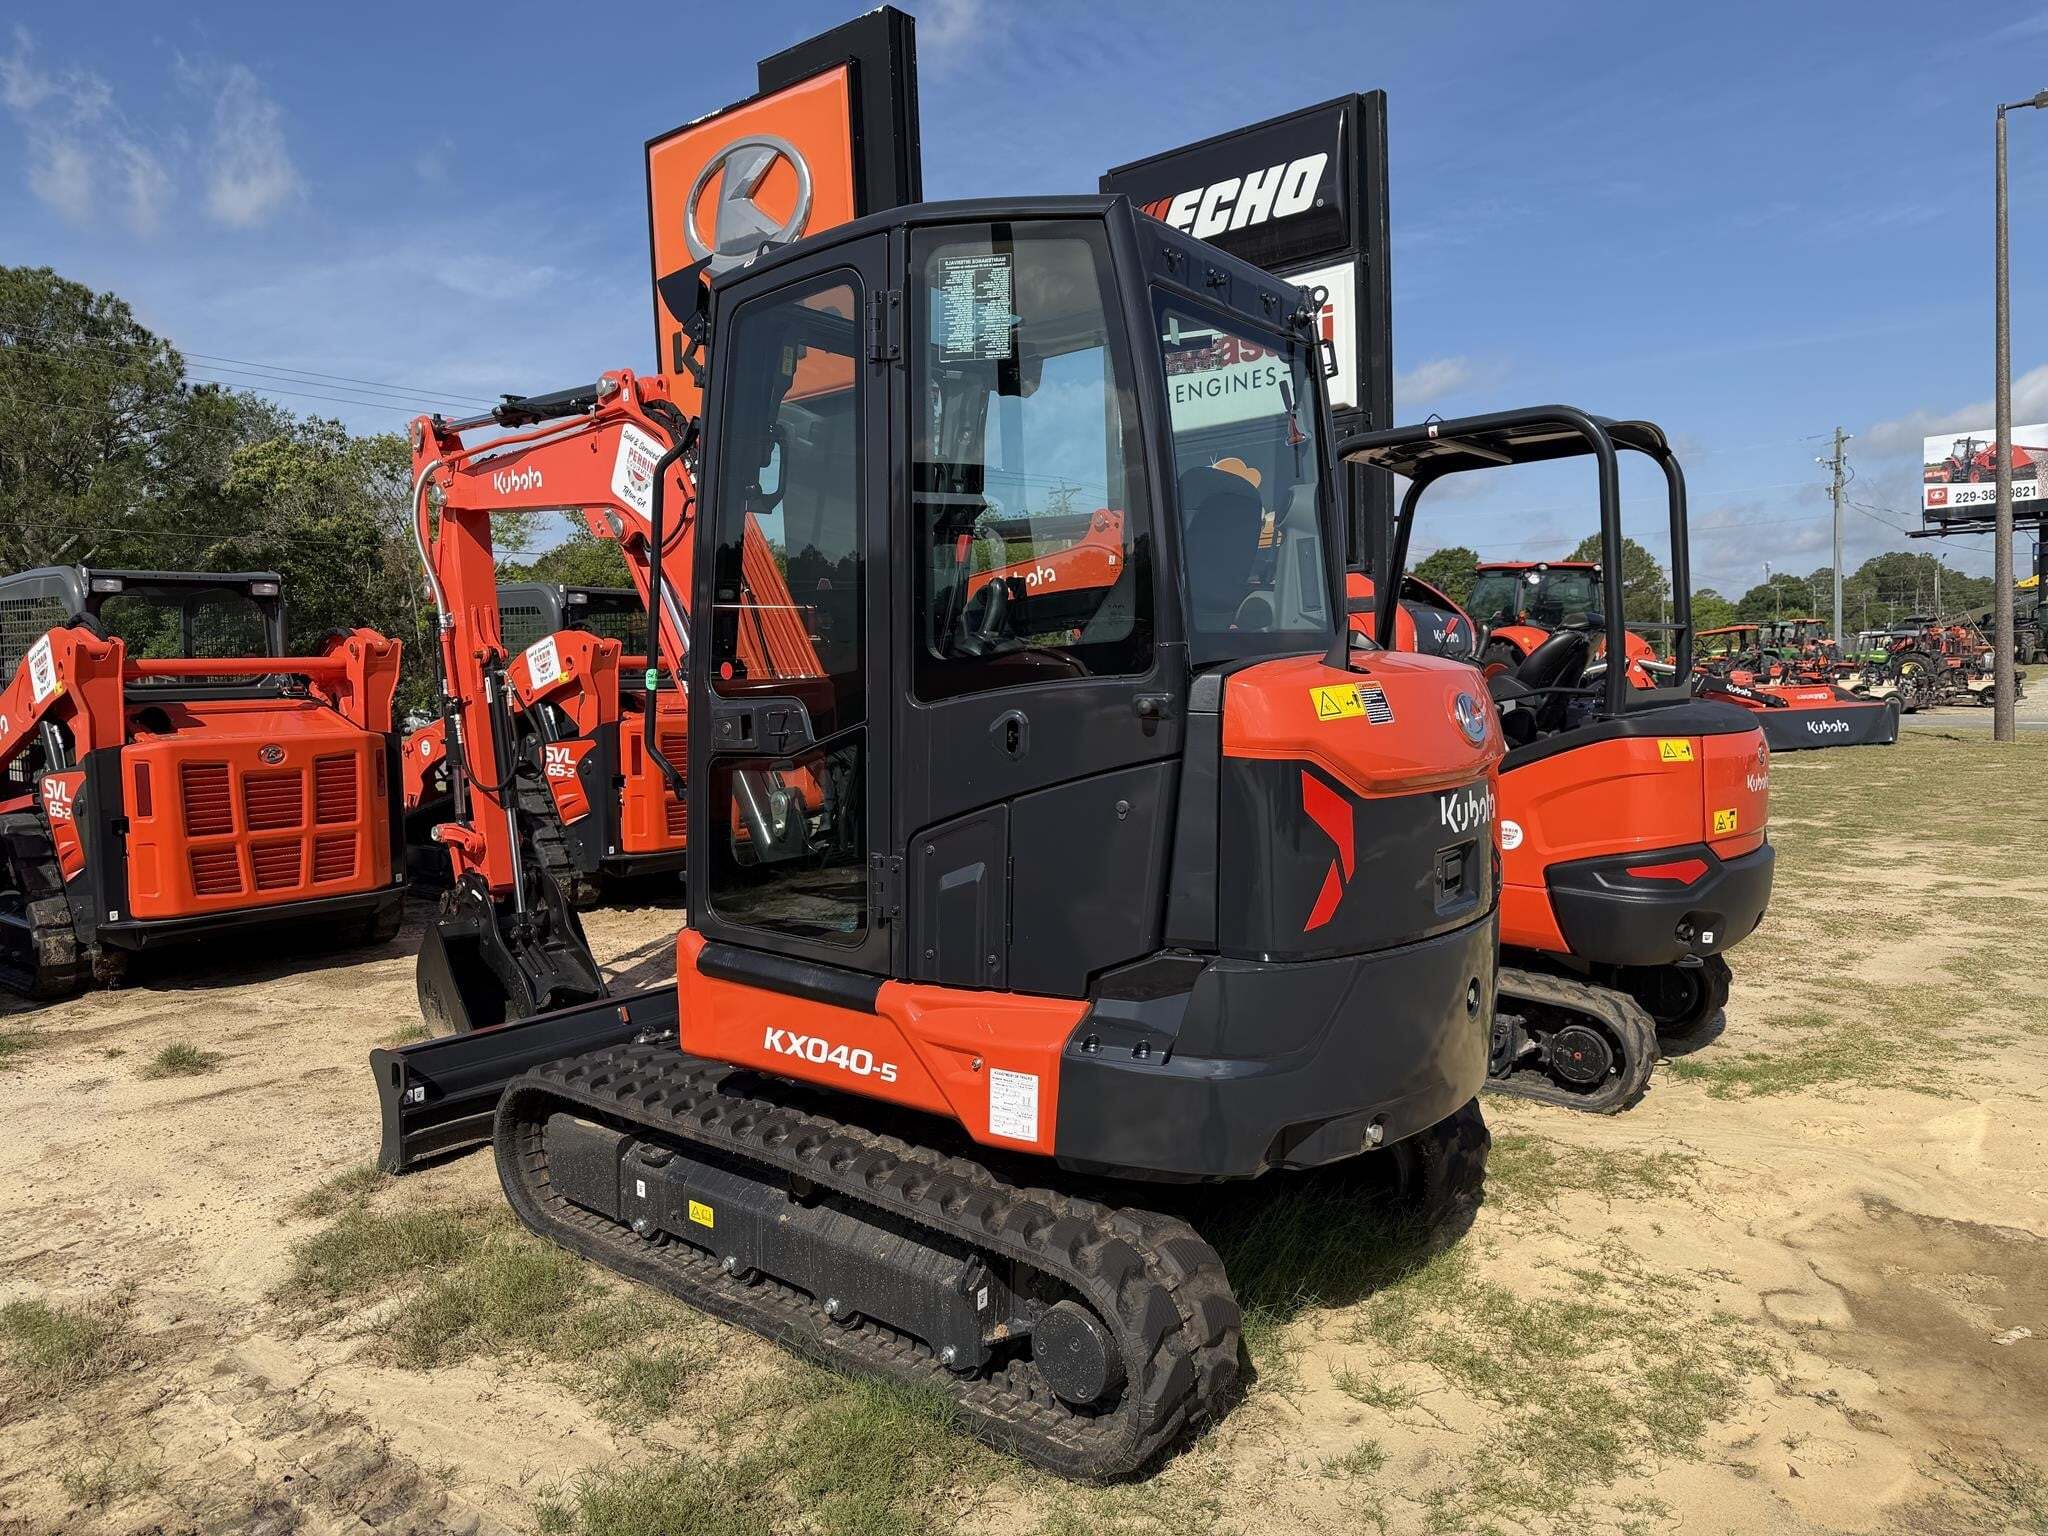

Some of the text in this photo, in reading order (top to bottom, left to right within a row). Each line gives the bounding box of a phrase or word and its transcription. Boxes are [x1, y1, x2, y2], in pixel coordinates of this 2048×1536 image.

[1165, 152, 1328, 239] ECHO
[1175, 366, 1277, 404] ENGINES
[493, 465, 543, 495] Kubota
[1726, 683, 1752, 697] Kubota
[1807, 719, 1850, 734] Kubota
[546, 746, 577, 765] SVL
[547, 763, 576, 778] 65-2
[44, 778, 72, 803] SVL
[49, 801, 72, 820] 65-2
[1440, 784, 1496, 833] Kubota
[763, 1026, 898, 1083] KX040-5
